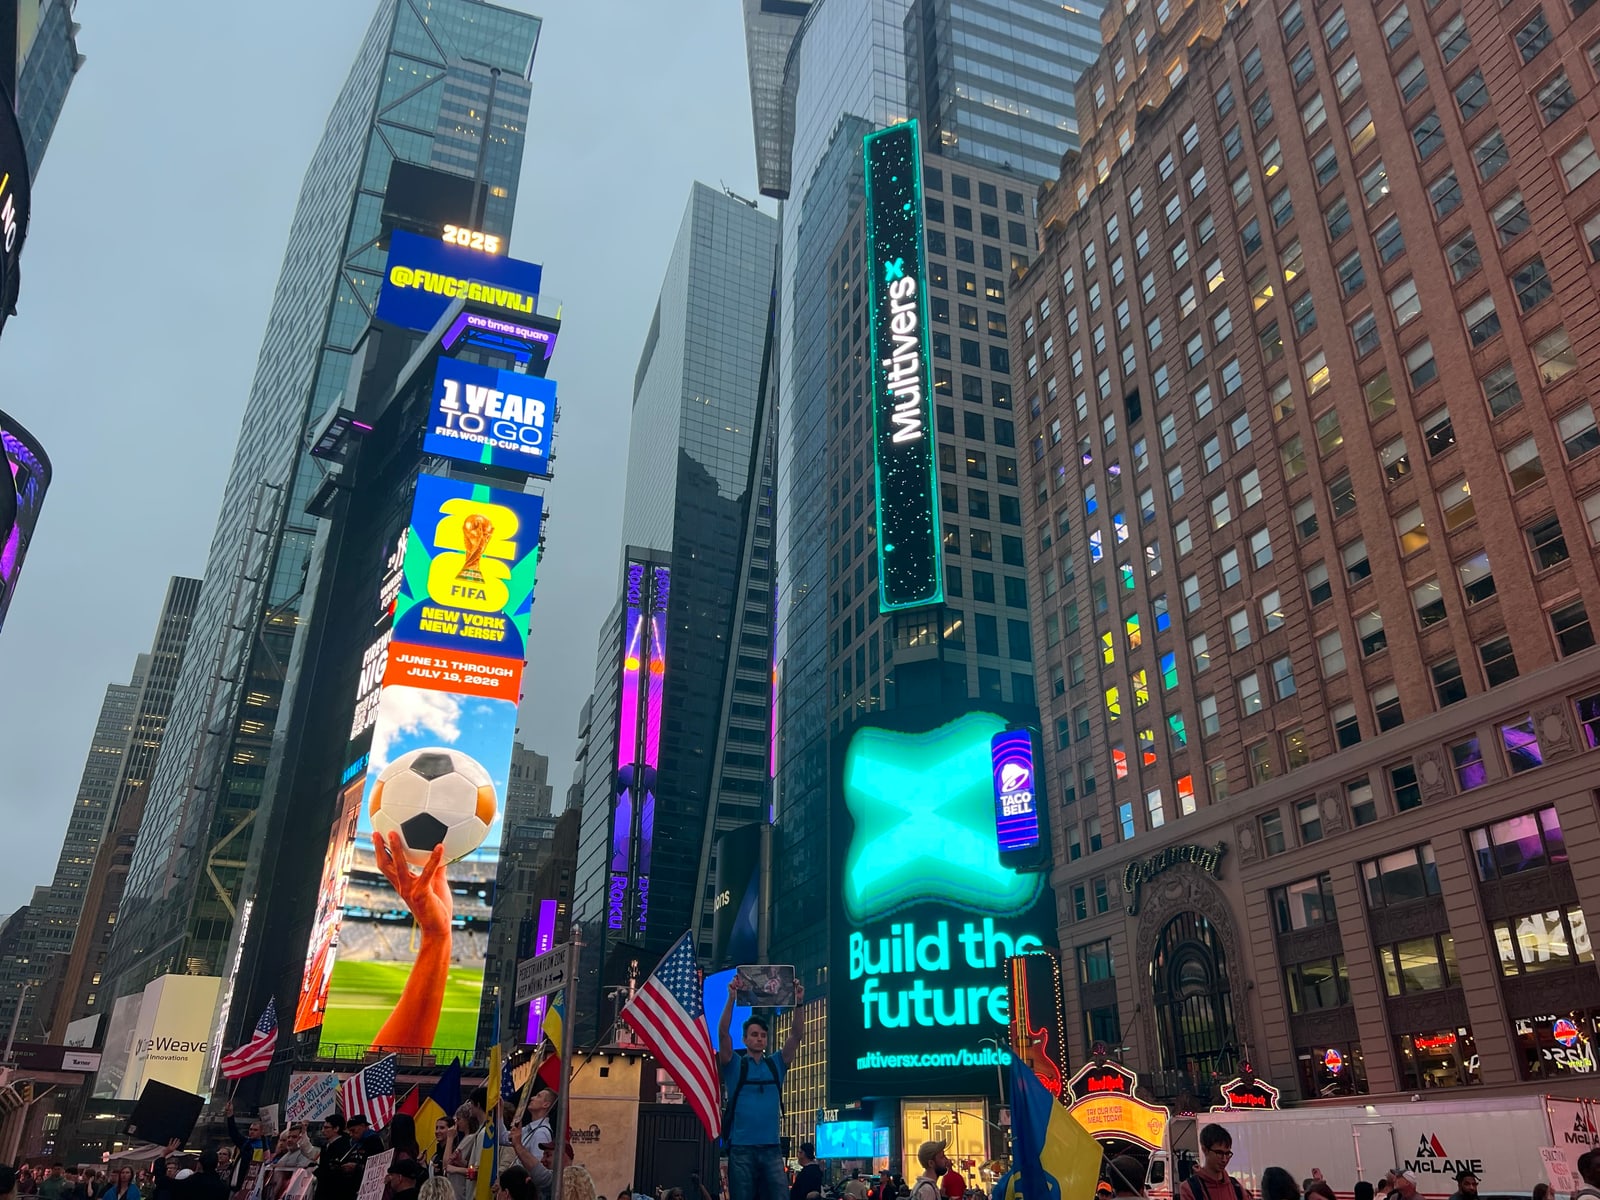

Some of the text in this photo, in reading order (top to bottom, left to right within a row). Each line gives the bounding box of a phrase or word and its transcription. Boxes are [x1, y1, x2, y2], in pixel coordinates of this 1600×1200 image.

[442, 224, 500, 254] 2025
[467, 315, 549, 341] one times square
[440, 379, 546, 428] 1 YEAR
[439, 407, 543, 446] TO GO
[435, 426, 459, 439] FIFA
[459, 431, 498, 446] WORLD
[498, 440, 520, 451] CUP
[450, 585, 487, 601] FIFA
[421, 607, 506, 630] NEW YORK
[419, 619, 505, 642] NEW JERSEY
[396, 654, 514, 677] JUNE 11 THROUGH
[406, 668, 500, 687] JULY 19, 2026
[1000, 791, 1032, 807] TACO
[1003, 803, 1033, 817] BELL
[608, 876, 628, 929] ROKU
[849, 920, 949, 980] Build
[861, 978, 1010, 1029] future
[823, 1108, 839, 1122] AT&T
[1404, 1158, 1484, 1174] McLANE
